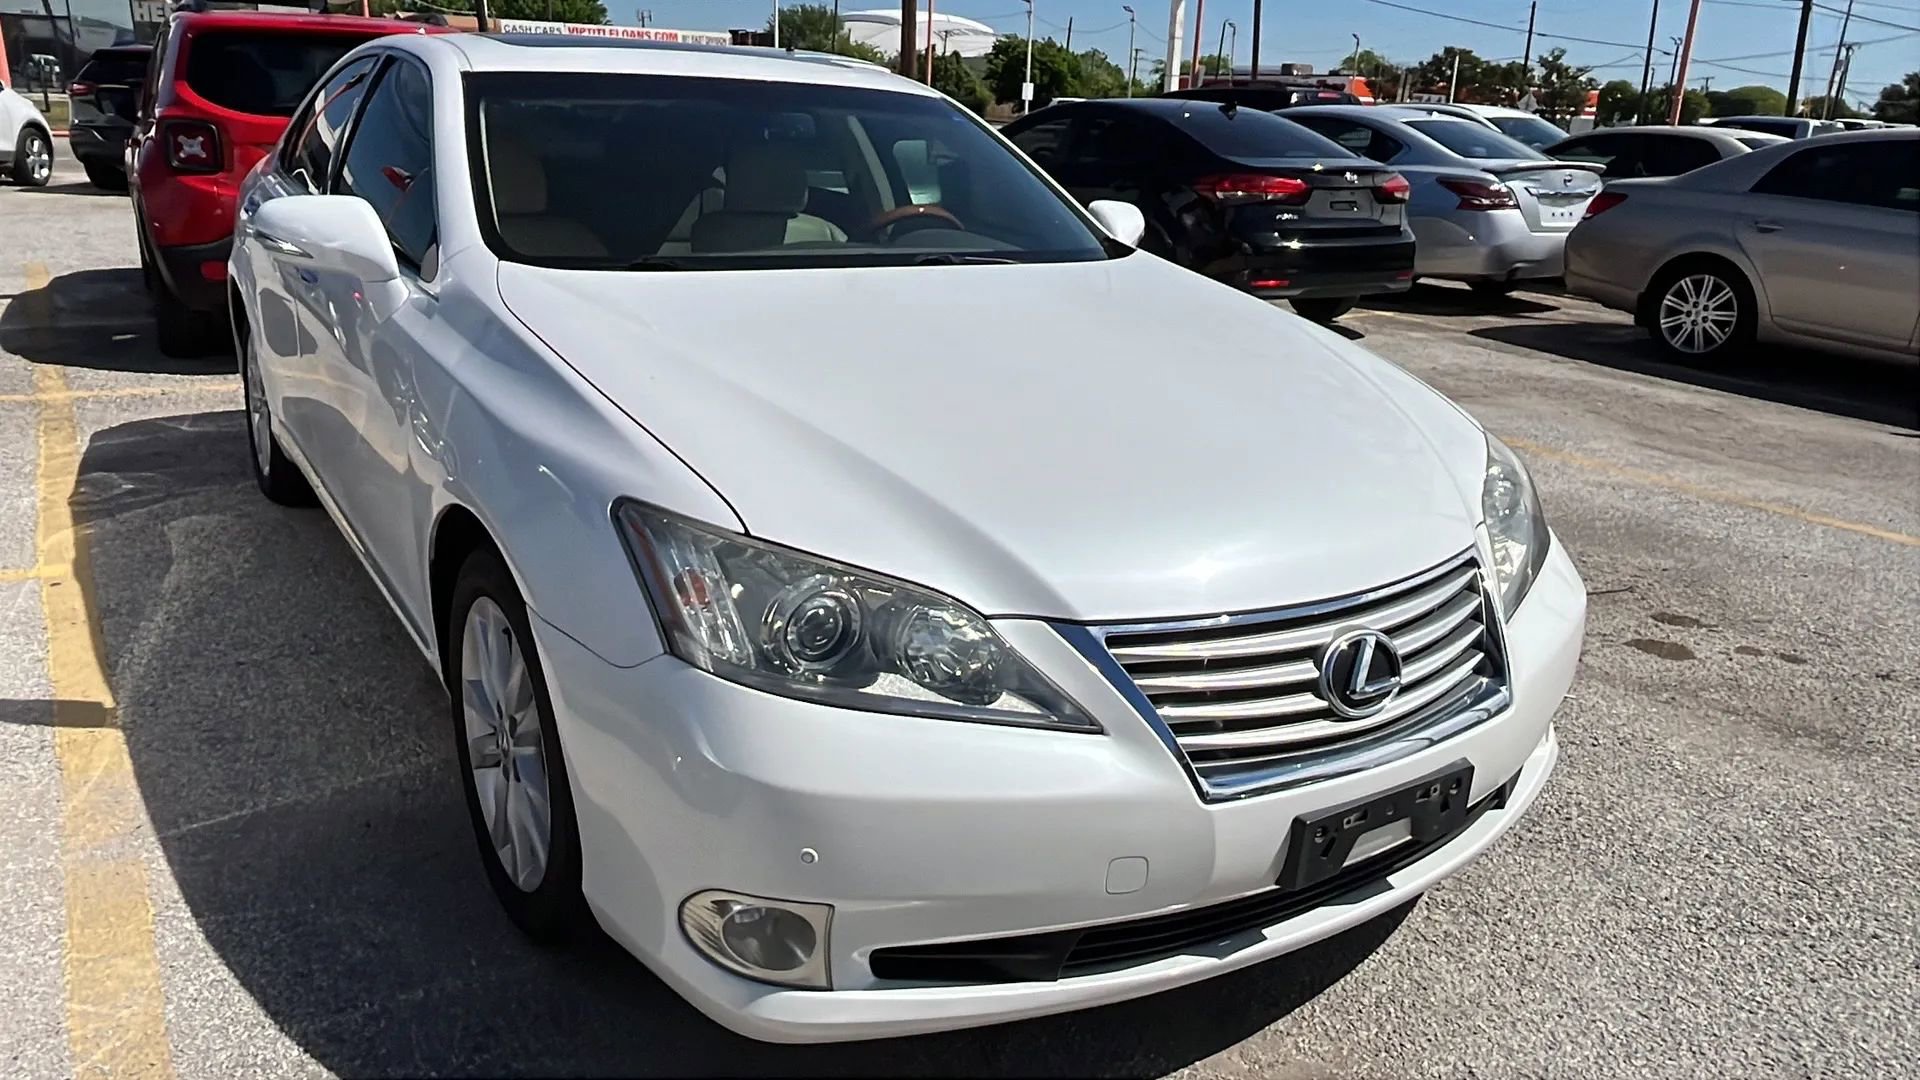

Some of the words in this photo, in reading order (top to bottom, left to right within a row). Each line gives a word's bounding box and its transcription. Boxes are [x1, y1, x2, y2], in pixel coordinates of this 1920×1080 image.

[503, 24, 532, 33] CASH
[535, 26, 562, 34] CARS
[567, 26, 679, 42] VIPTITLELOANSCOM
